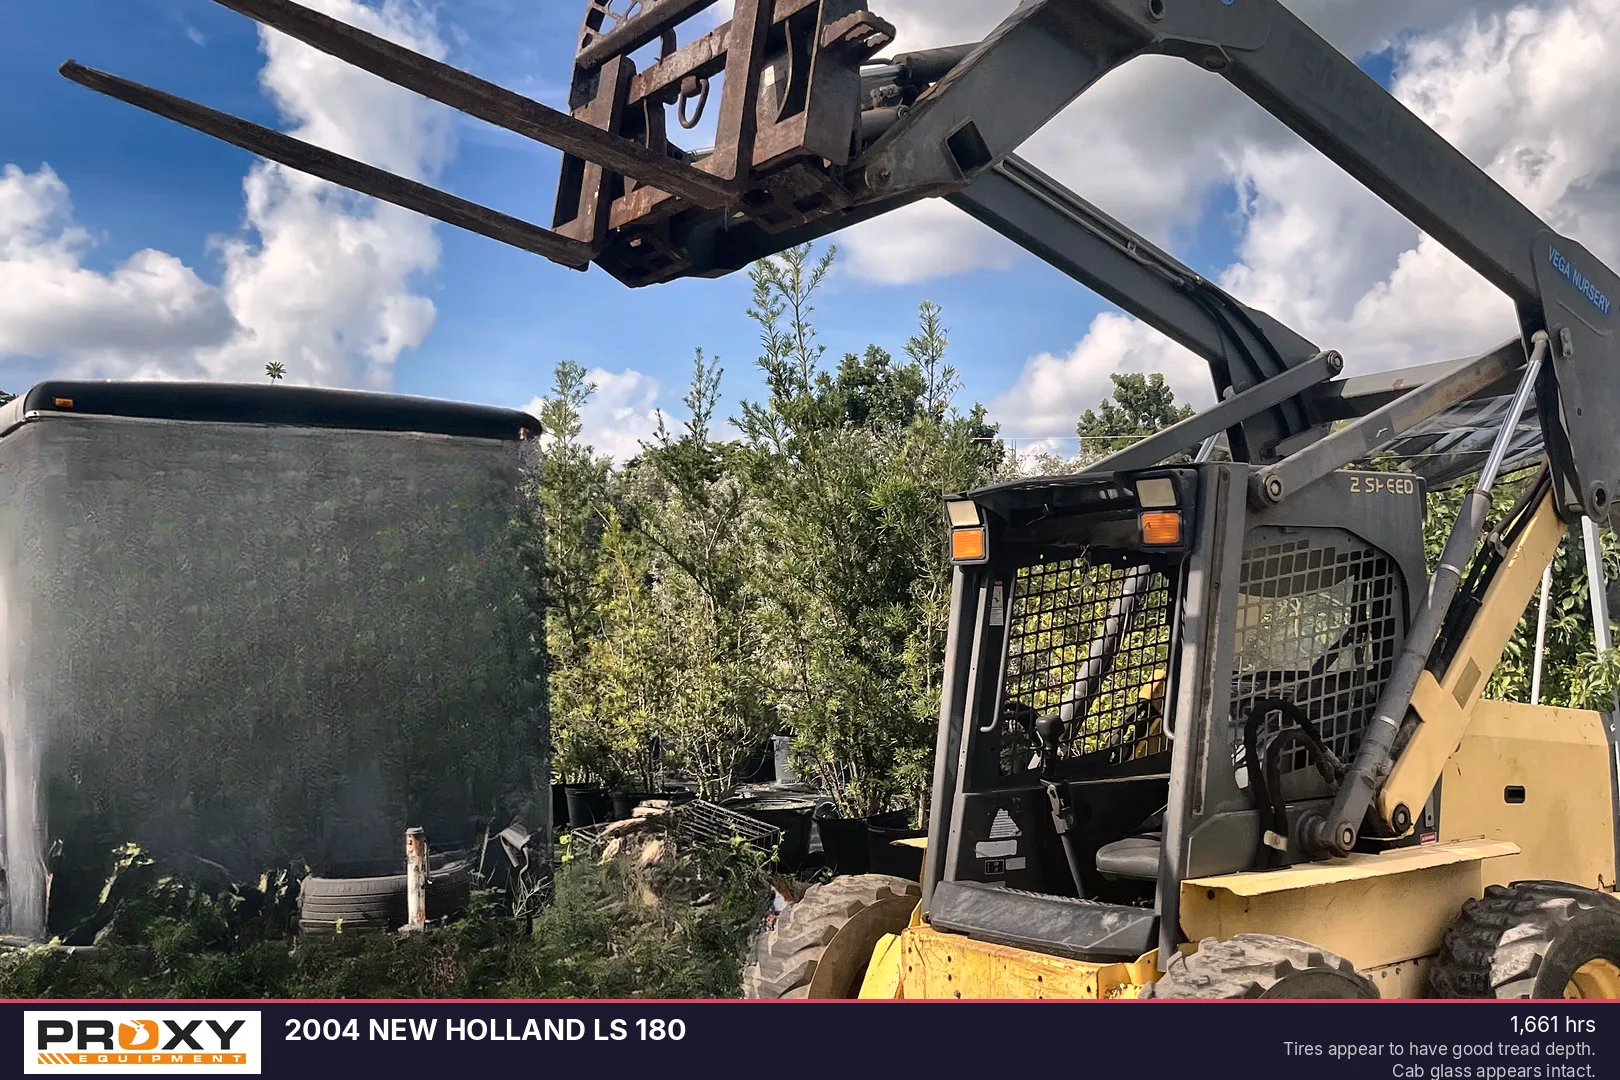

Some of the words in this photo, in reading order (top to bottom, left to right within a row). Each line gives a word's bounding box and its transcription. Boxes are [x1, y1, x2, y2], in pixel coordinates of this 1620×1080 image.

[1548, 245, 1570, 278] VEGA
[1572, 269, 1610, 313] NURSERY
[1350, 476, 1360, 493] 2
